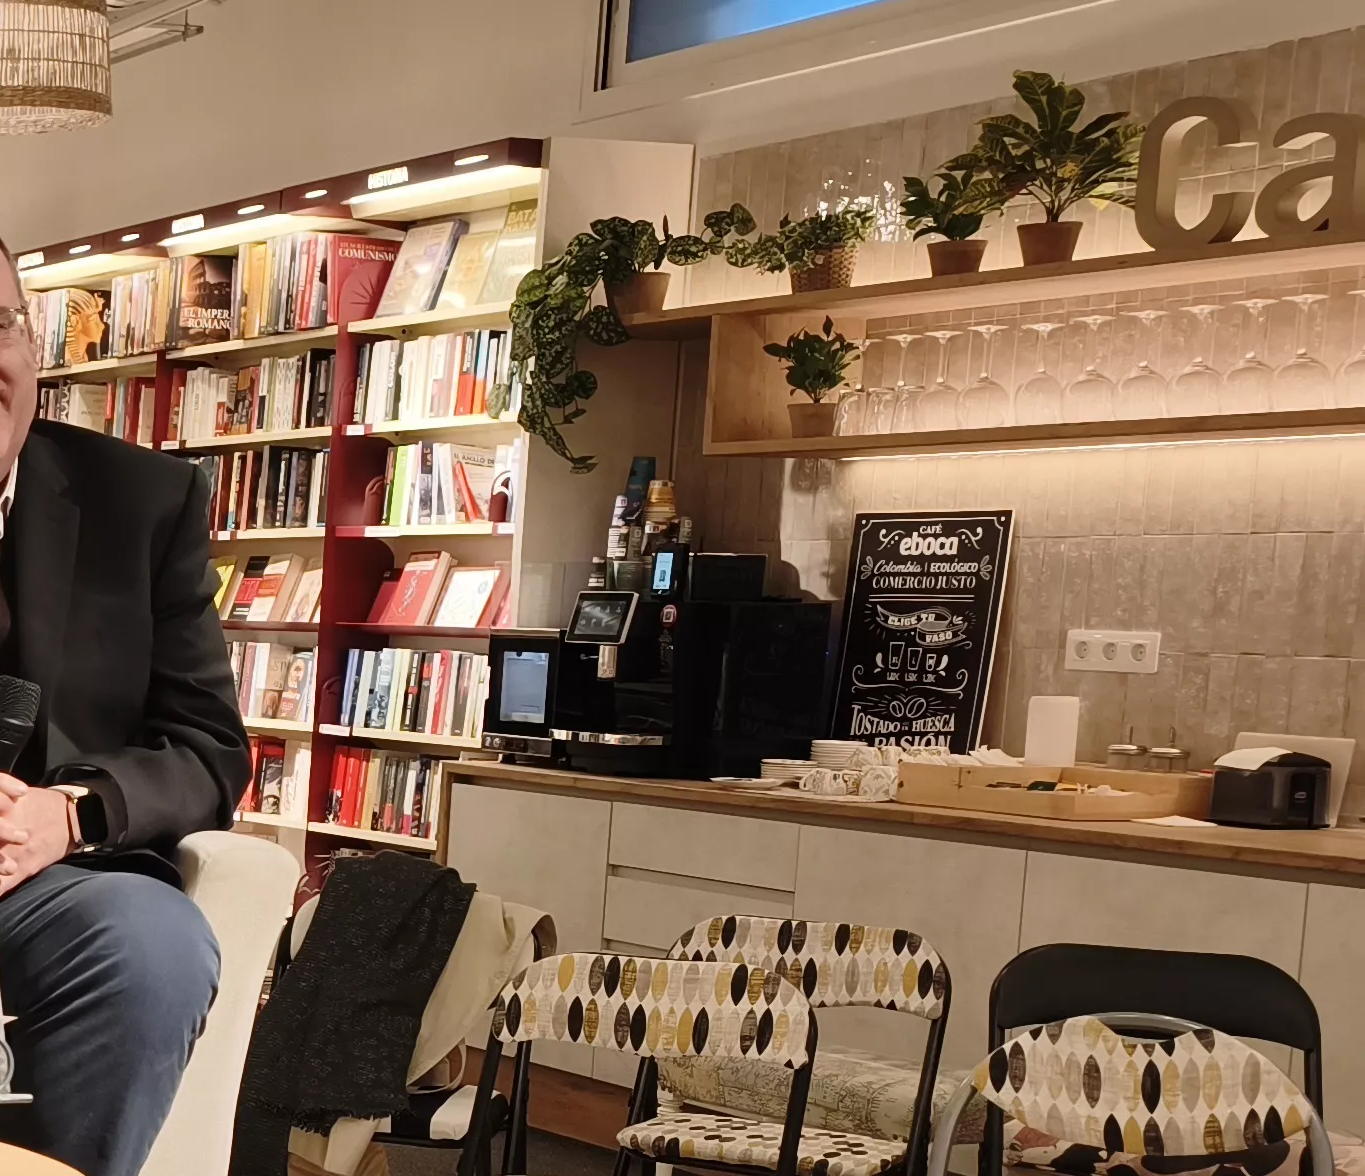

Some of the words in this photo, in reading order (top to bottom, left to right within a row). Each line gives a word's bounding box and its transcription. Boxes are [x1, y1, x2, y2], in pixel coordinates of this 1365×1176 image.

[199, 308, 233, 320] IMPER
[919, 522, 943, 534] CAFÉ
[899, 531, 959, 555] eboca
[874, 560, 922, 574] Colombia
[930, 558, 978, 572] ECOLÓGICO
[872, 575, 935, 589] COMERCIO
[936, 575, 976, 589] JUSTO
[925, 631, 952, 642] VASO
[849, 705, 900, 736] TOSTADO
[911, 713, 955, 732] HUESCA
